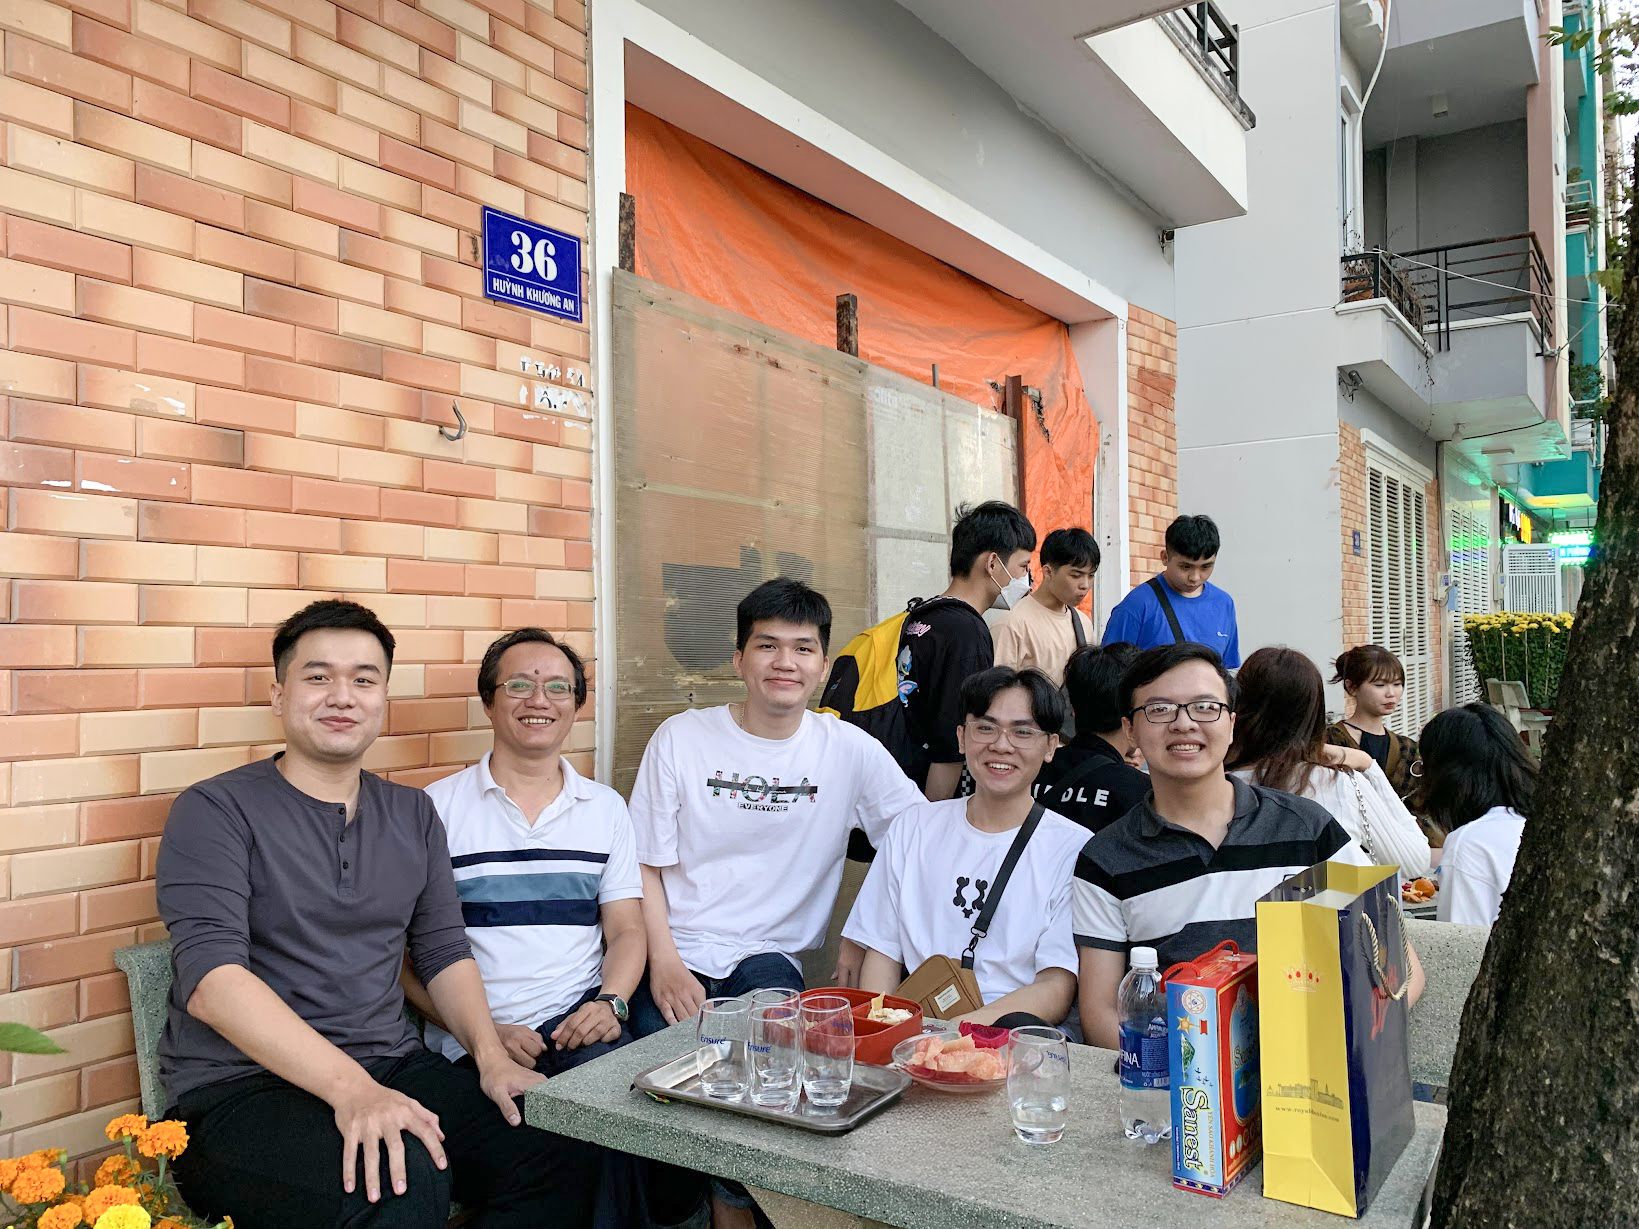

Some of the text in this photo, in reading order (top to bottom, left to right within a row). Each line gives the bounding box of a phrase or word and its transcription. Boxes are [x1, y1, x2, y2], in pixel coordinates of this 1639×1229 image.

[511, 230, 557, 281] 36
[492, 277, 575, 312] HUỲNH KHƯƠNG AN
[713, 770, 816, 803] HOLA
[737, 802, 788, 812] EVERYONE
[700, 1034, 726, 1045] Ensure
[1120, 1049, 1141, 1068] FINA
[1181, 1087, 1210, 1170] Sanest
